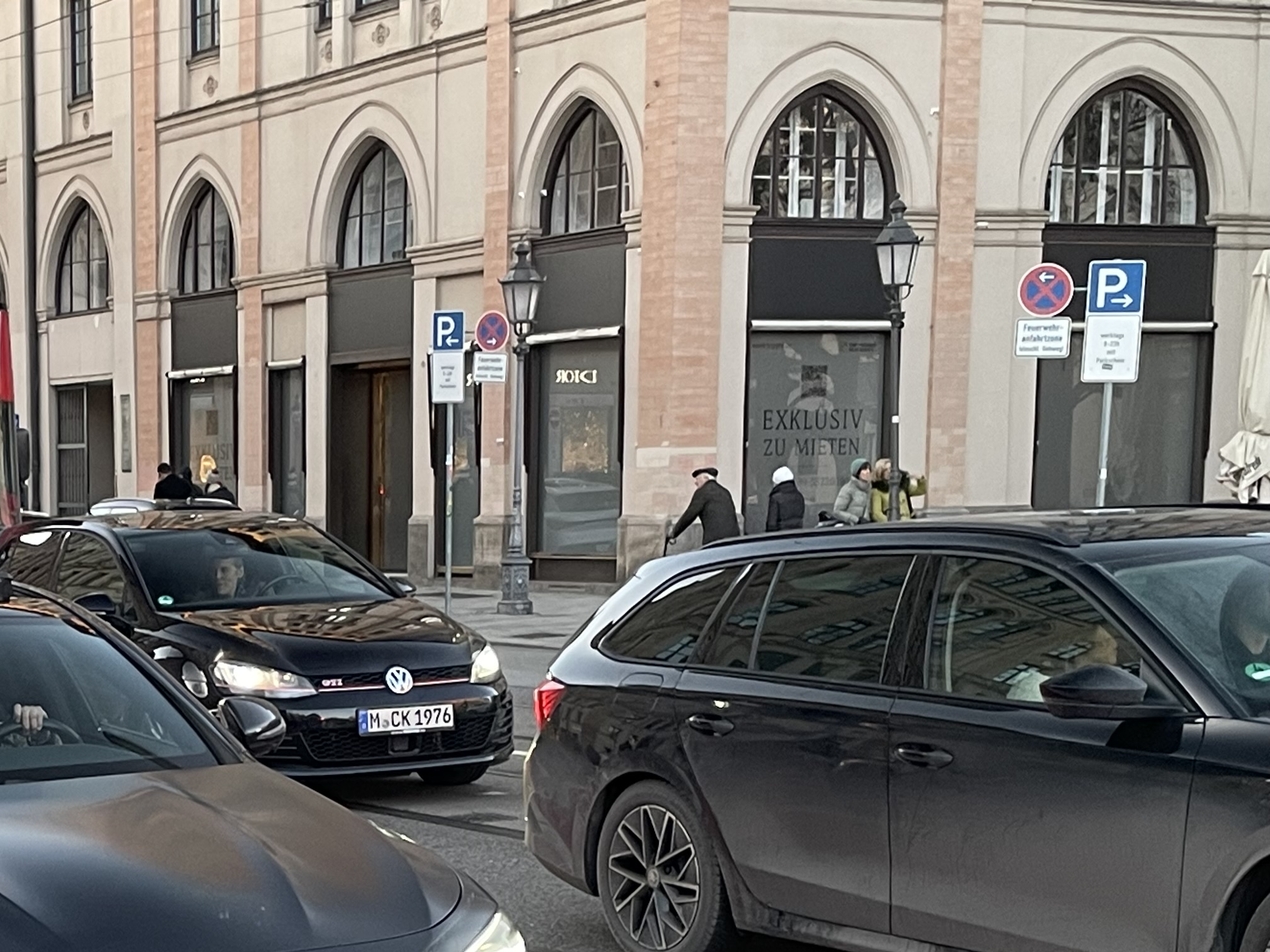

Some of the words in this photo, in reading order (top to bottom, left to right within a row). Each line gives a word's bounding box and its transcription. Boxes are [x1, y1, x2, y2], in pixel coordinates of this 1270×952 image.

[1096, 267, 1128, 308] P
[437, 316, 456, 347] P
[762, 408, 864, 431] EXKLUSIV
[763, 438, 786, 457] ZU
[795, 437, 860, 456] MIETEN
[369, 712, 380, 729] M
[391, 710, 411, 728] CK
[414, 707, 451, 726] 1976
